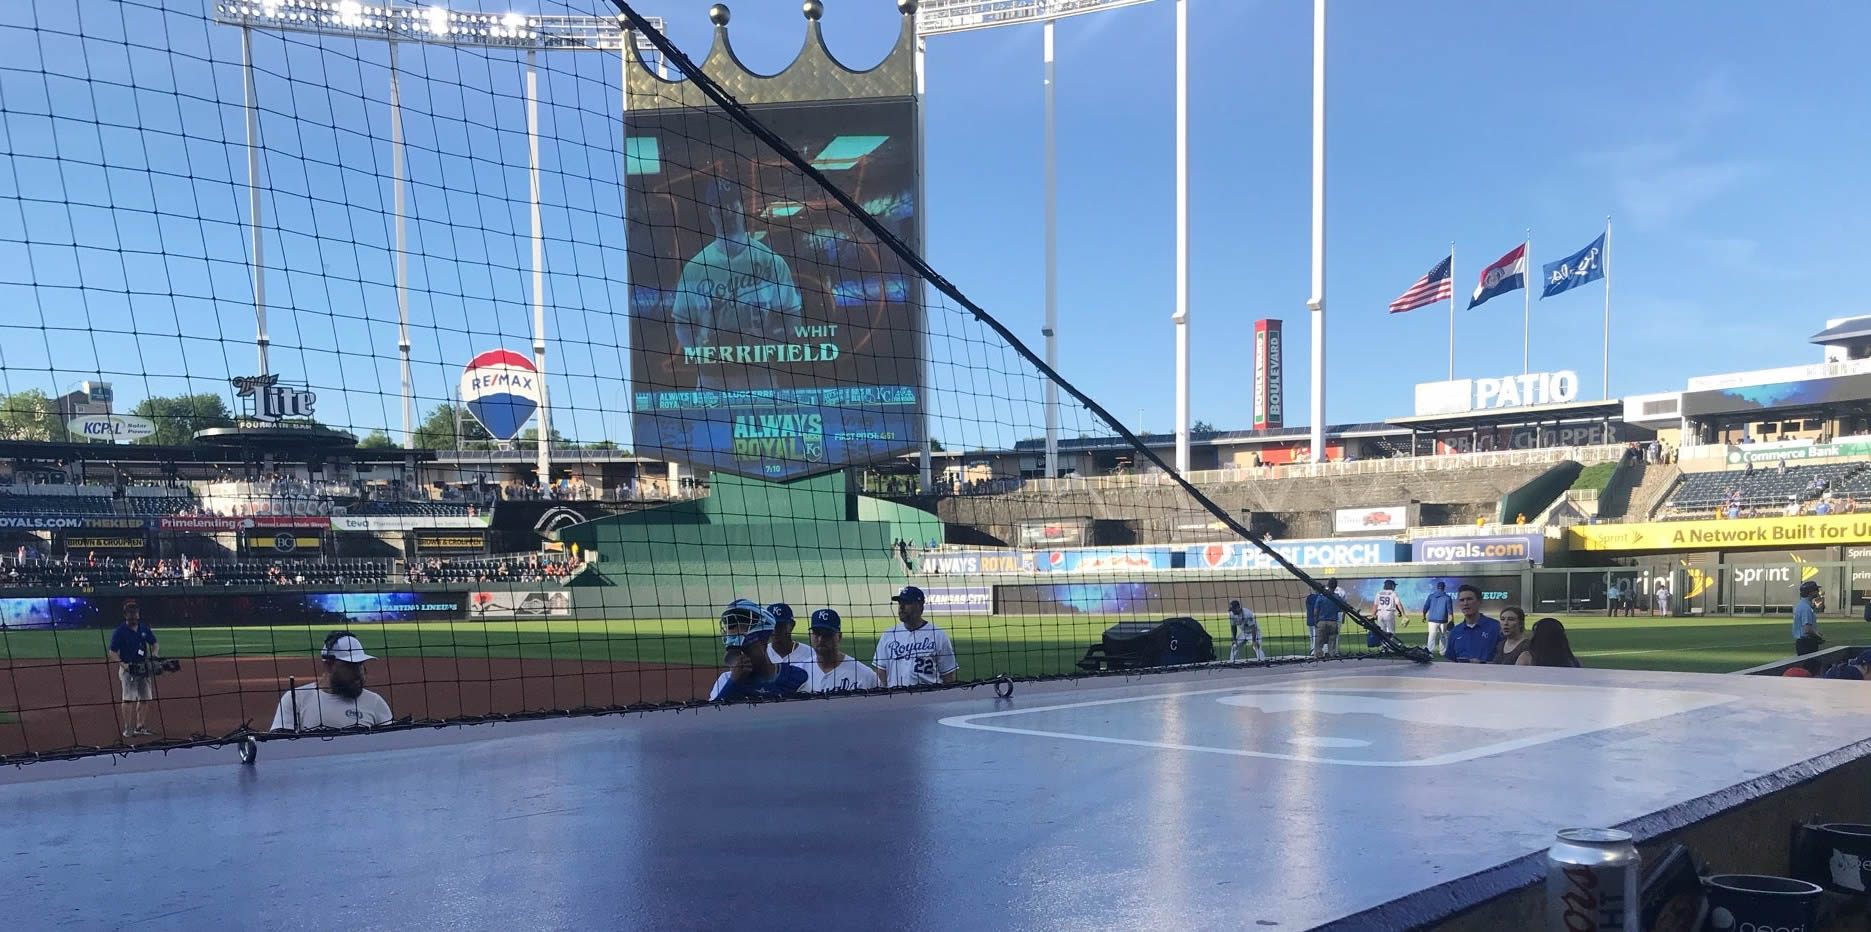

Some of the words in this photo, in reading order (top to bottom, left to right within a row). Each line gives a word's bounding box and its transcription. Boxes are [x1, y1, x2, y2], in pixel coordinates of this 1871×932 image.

[794, 325, 838, 338] WHIT
[684, 343, 839, 364] MERRIFIELD
[472, 374, 532, 391] RE/MAX
[1270, 337, 1280, 415] BOULEVARD
[1476, 370, 1578, 410] PATIO
[252, 385, 316, 422] Lite
[84, 421, 122, 435] KCP&L
[734, 414, 822, 437] ALWAYS
[735, 438, 804, 461] ROYAL
[1743, 449, 1805, 462] Commerce
[1808, 446, 1839, 457] Bank
[162, 518, 236, 529] PrimeLending
[346, 519, 369, 527] teva
[1673, 529, 1685, 543] A
[1690, 526, 1767, 542] Network
[1772, 525, 1815, 540] Built
[1820, 524, 1848, 538] for
[1304, 543, 1379, 565] PORCH
[1427, 543, 1524, 561] royals.com
[923, 557, 976, 573] ALWAYS
[980, 556, 1023, 572] ROYAL
[1735, 565, 1789, 586] Sprint
[968, 594, 988, 604] CITY
[1379, 596, 1390, 606] 58
[772, 606, 782, 616] KC
[818, 610, 829, 621] KC
[888, 637, 937, 661] Royals
[914, 657, 934, 675] 22
